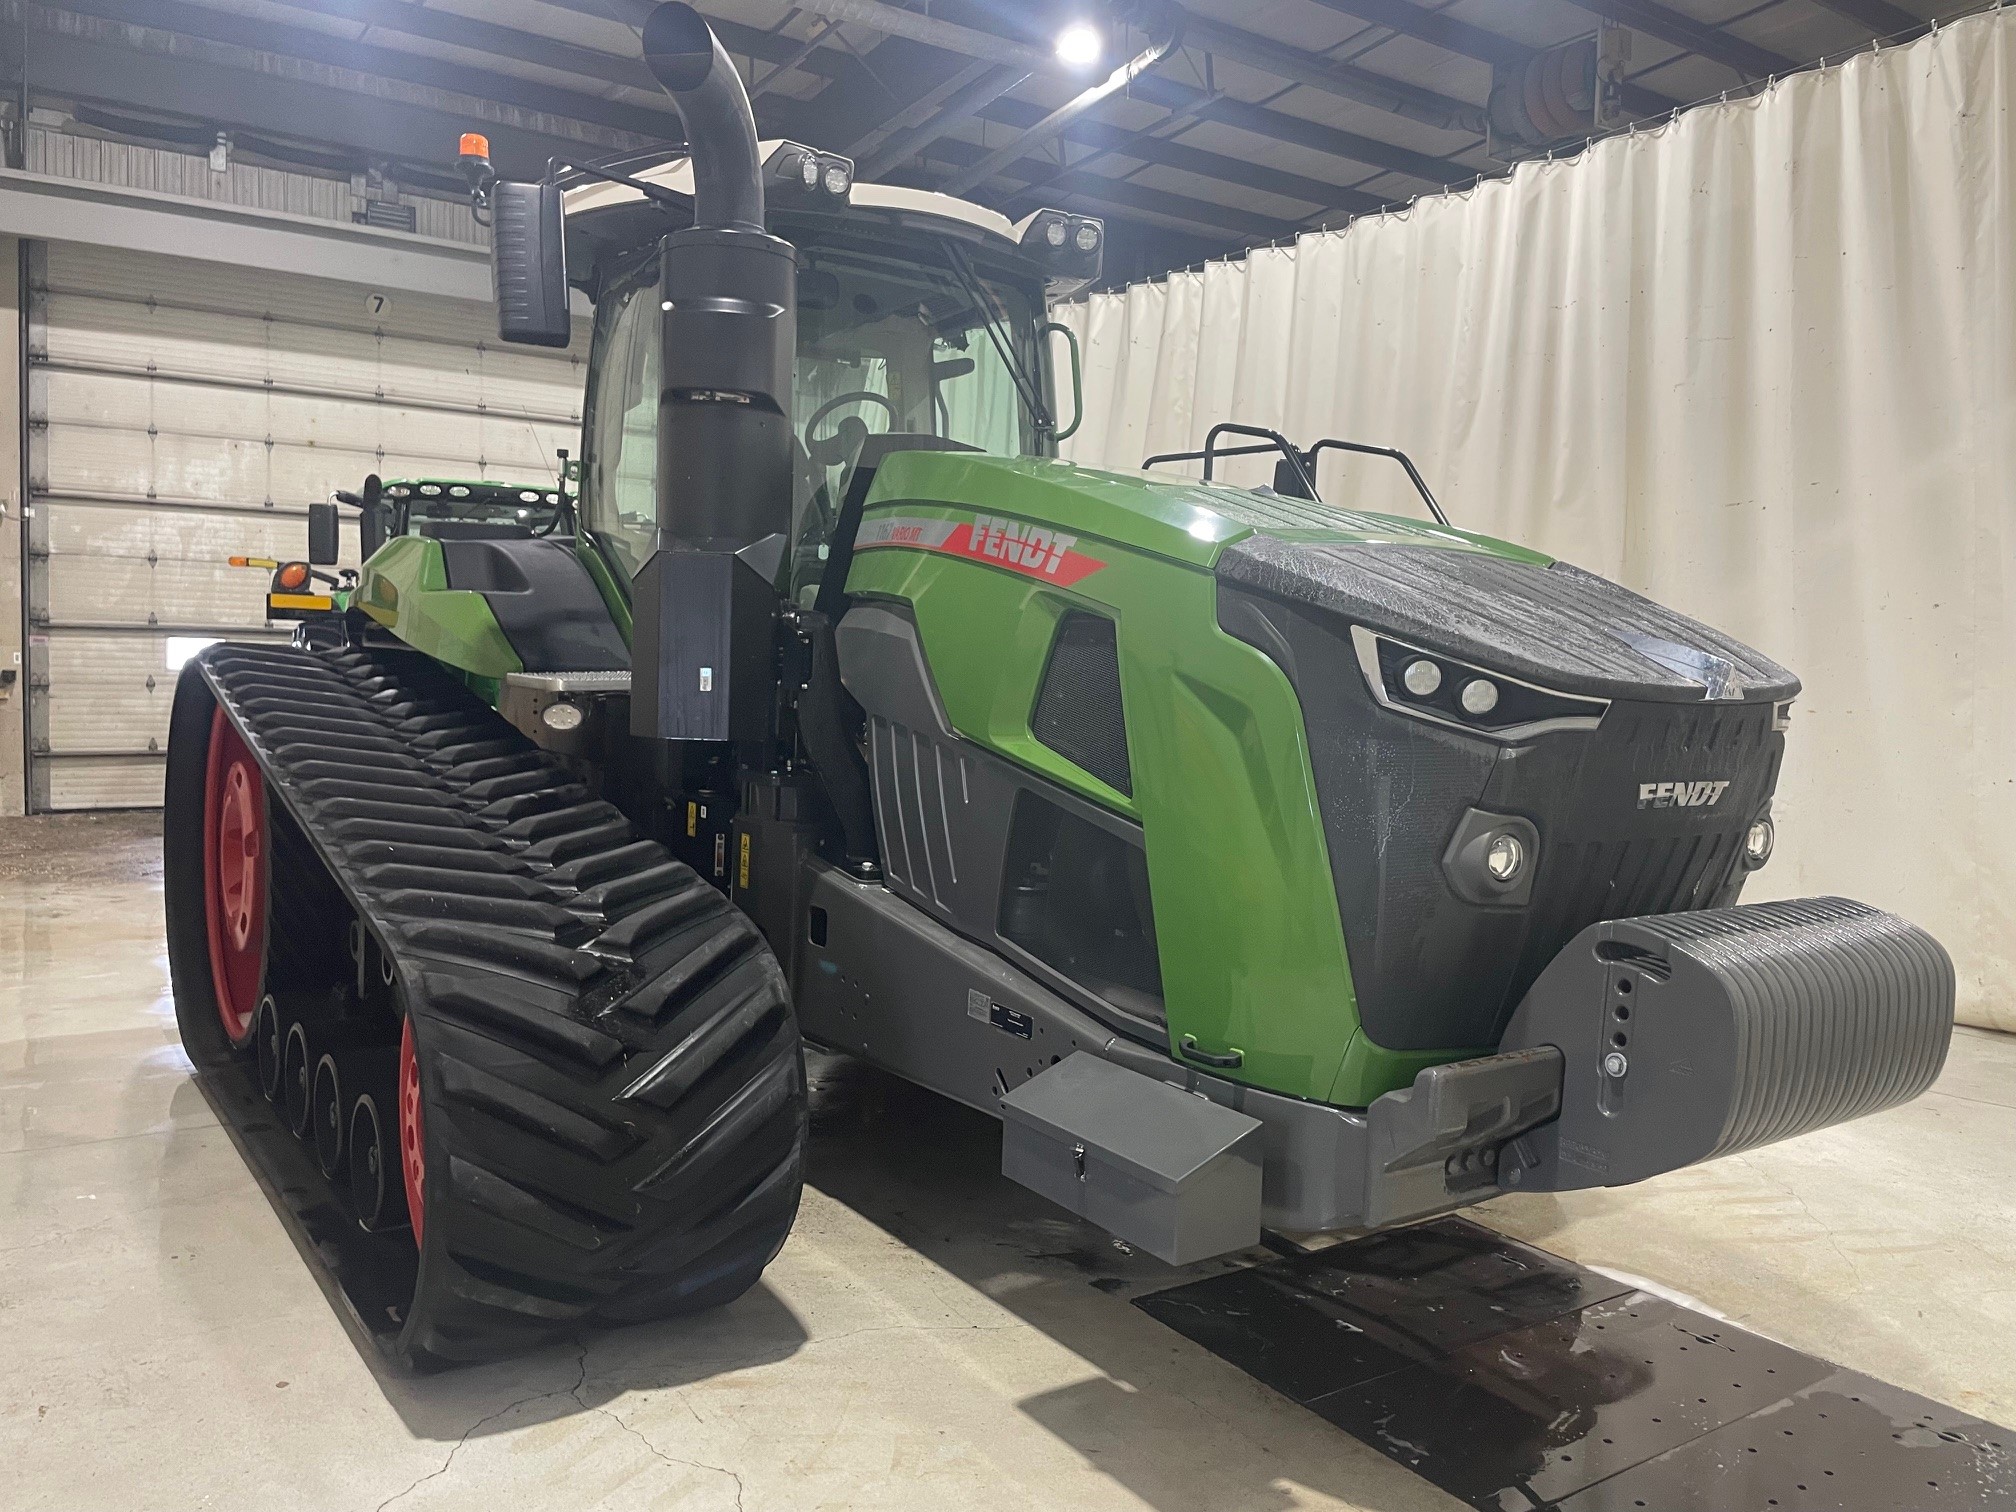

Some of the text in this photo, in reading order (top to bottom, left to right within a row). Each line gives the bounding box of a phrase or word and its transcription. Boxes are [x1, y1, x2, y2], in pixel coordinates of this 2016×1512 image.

[373, 295, 385, 314] 7
[969, 513, 1077, 574] FENDT
[1637, 781, 1730, 810] FENDT
